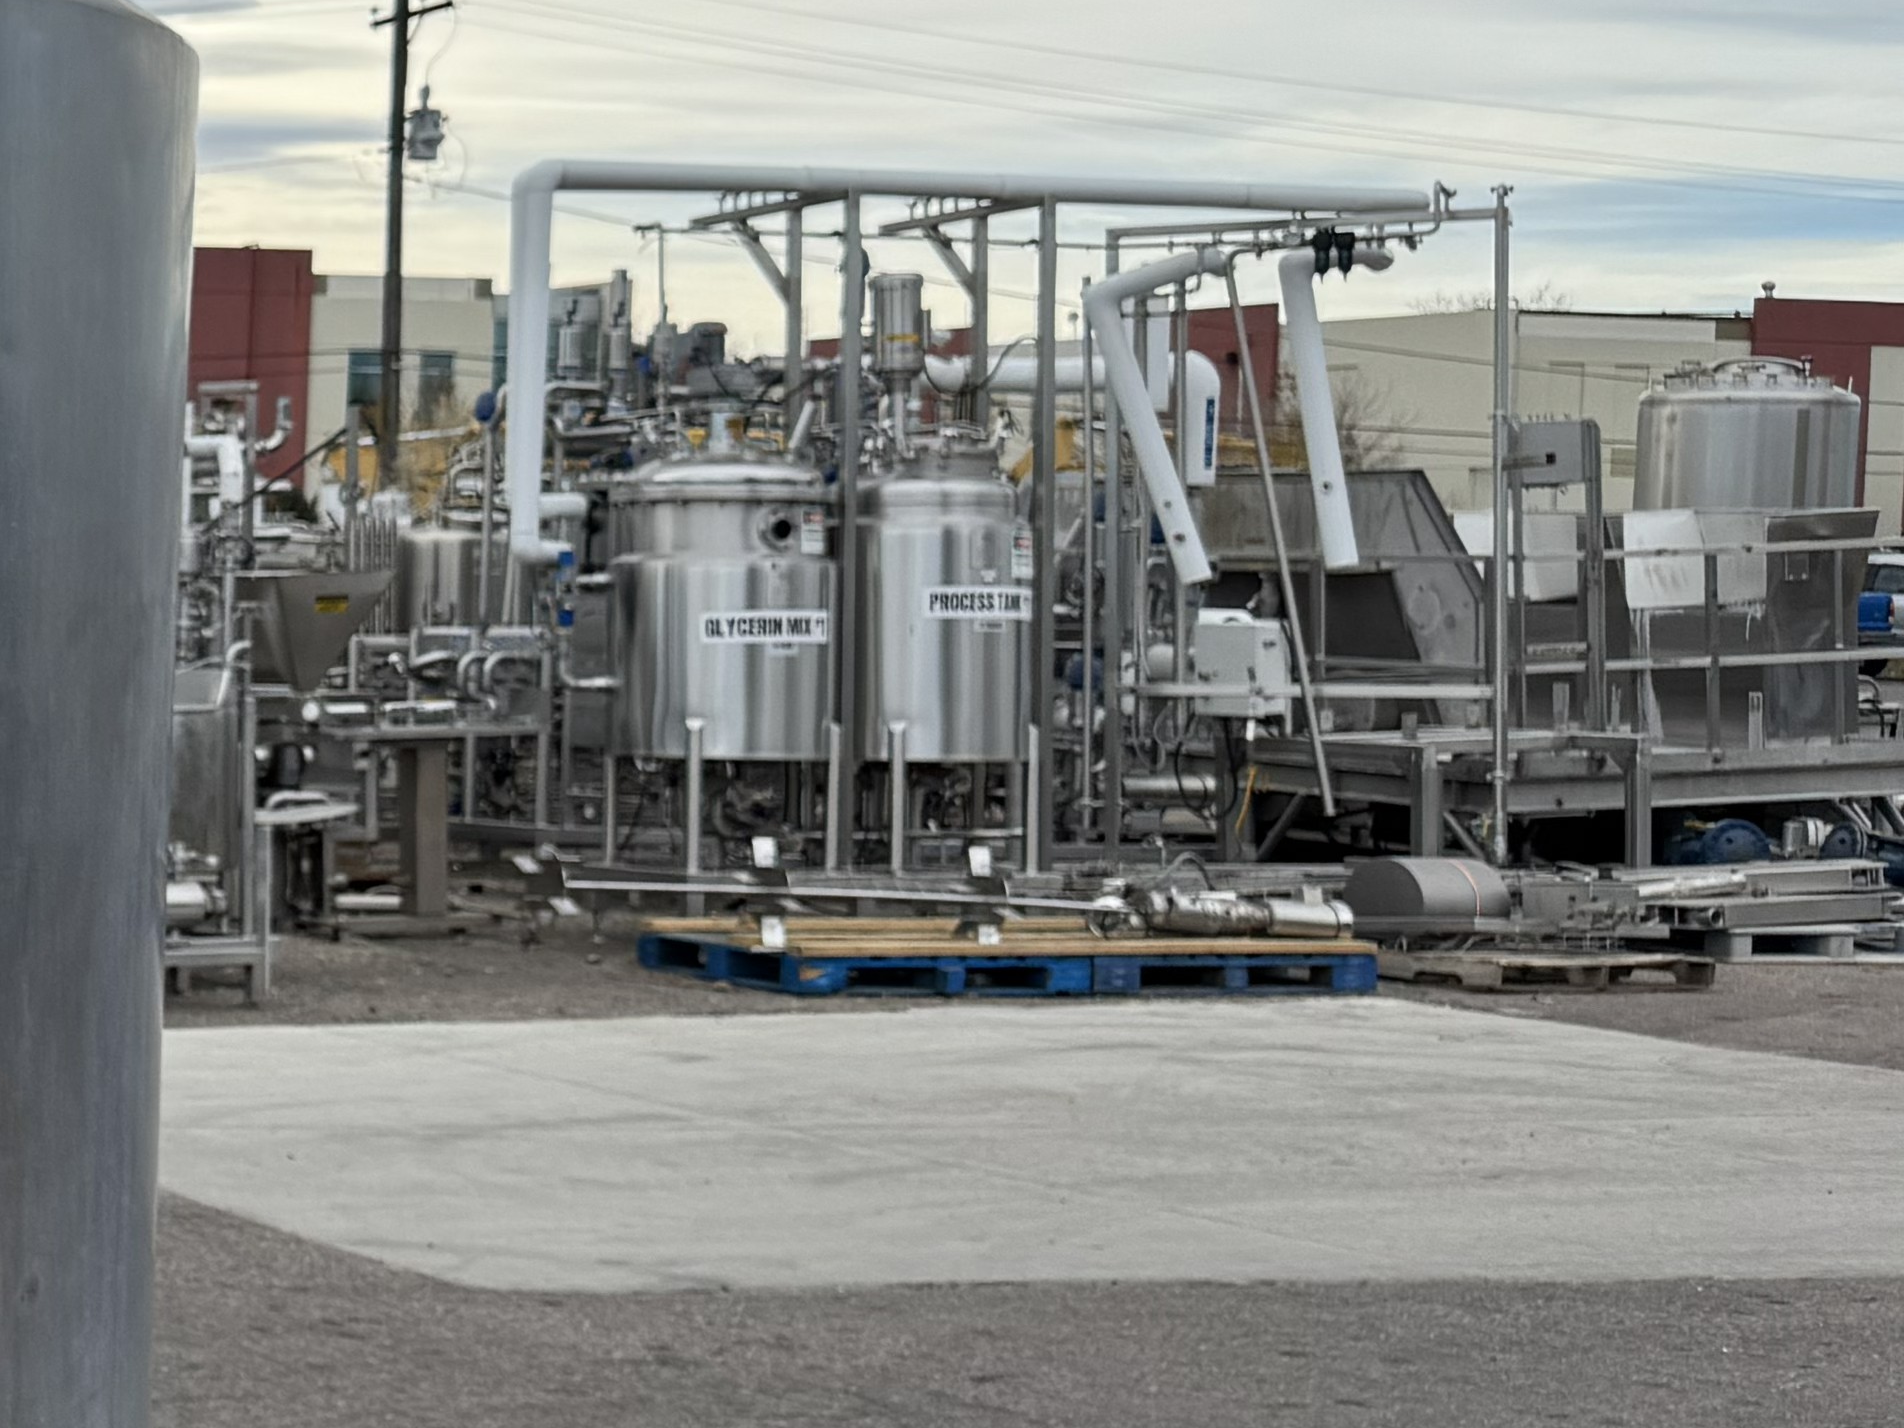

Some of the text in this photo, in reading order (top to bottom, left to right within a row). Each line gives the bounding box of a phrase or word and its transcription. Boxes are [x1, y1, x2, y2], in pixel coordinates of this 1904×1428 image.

[929, 593, 994, 611] PROCESS
[705, 617, 783, 638] GLYCERIN
[787, 617, 811, 635] MIX
